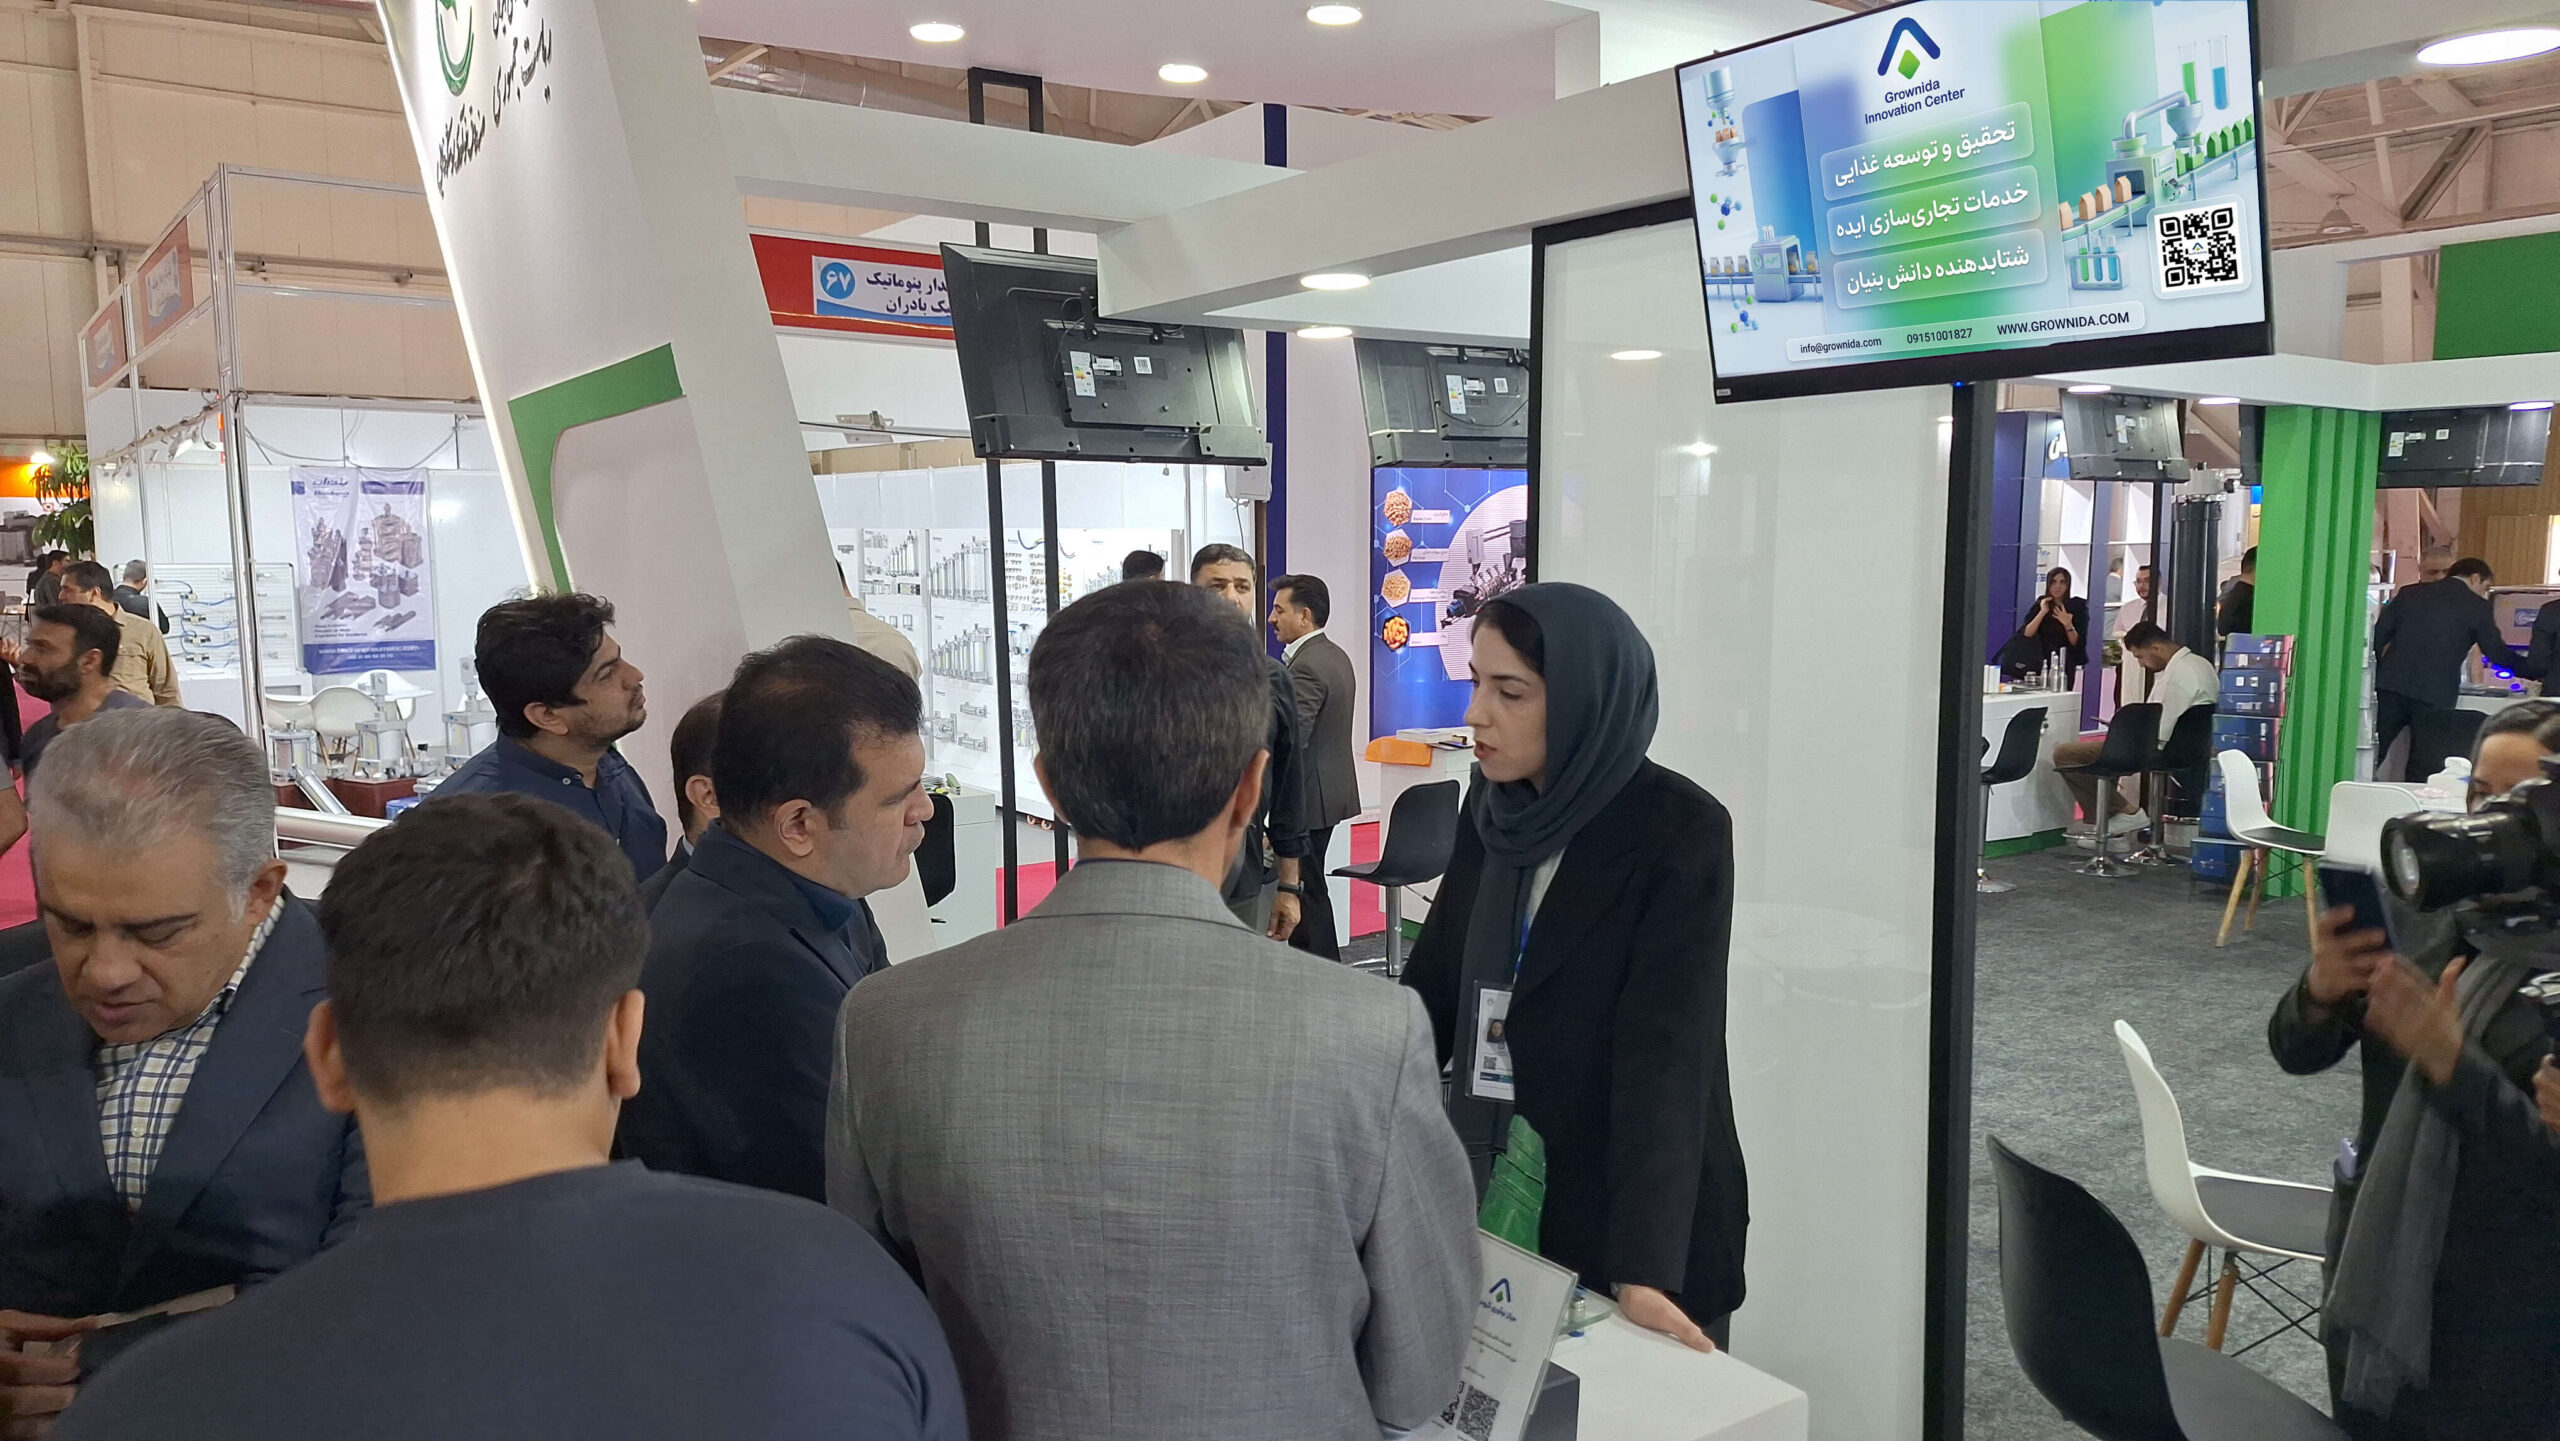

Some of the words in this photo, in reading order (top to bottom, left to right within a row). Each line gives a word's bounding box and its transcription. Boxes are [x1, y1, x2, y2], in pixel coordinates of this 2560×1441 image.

[1884, 79, 1941, 104] Grownida
[1864, 100, 1922, 125] Innovation
[1924, 88, 1966, 110] Center
[1941, 143, 1952, 162] و
[1956, 120, 2016, 159] تحقیق
[1883, 140, 1939, 168] توسعه
[1835, 156, 1880, 187] غذایی
[1963, 182, 2029, 211] خدمات
[1836, 215, 1866, 240] ایده
[1935, 245, 2030, 277] شتابدهنده
[825, 270, 852, 292] ۶۷
[866, 272, 922, 295] پنوماتیک
[926, 277, 948, 295] دار
[1847, 271, 1884, 295] بنیان
[1887, 262, 1932, 290] دانش
[886, 296, 927, 316] بادران
[1800, 337, 1882, 355] info@grownida.com
[1906, 327, 1973, 345] 09151001827
[1996, 311, 2130, 336] WWW.GROWNIDA.COM
